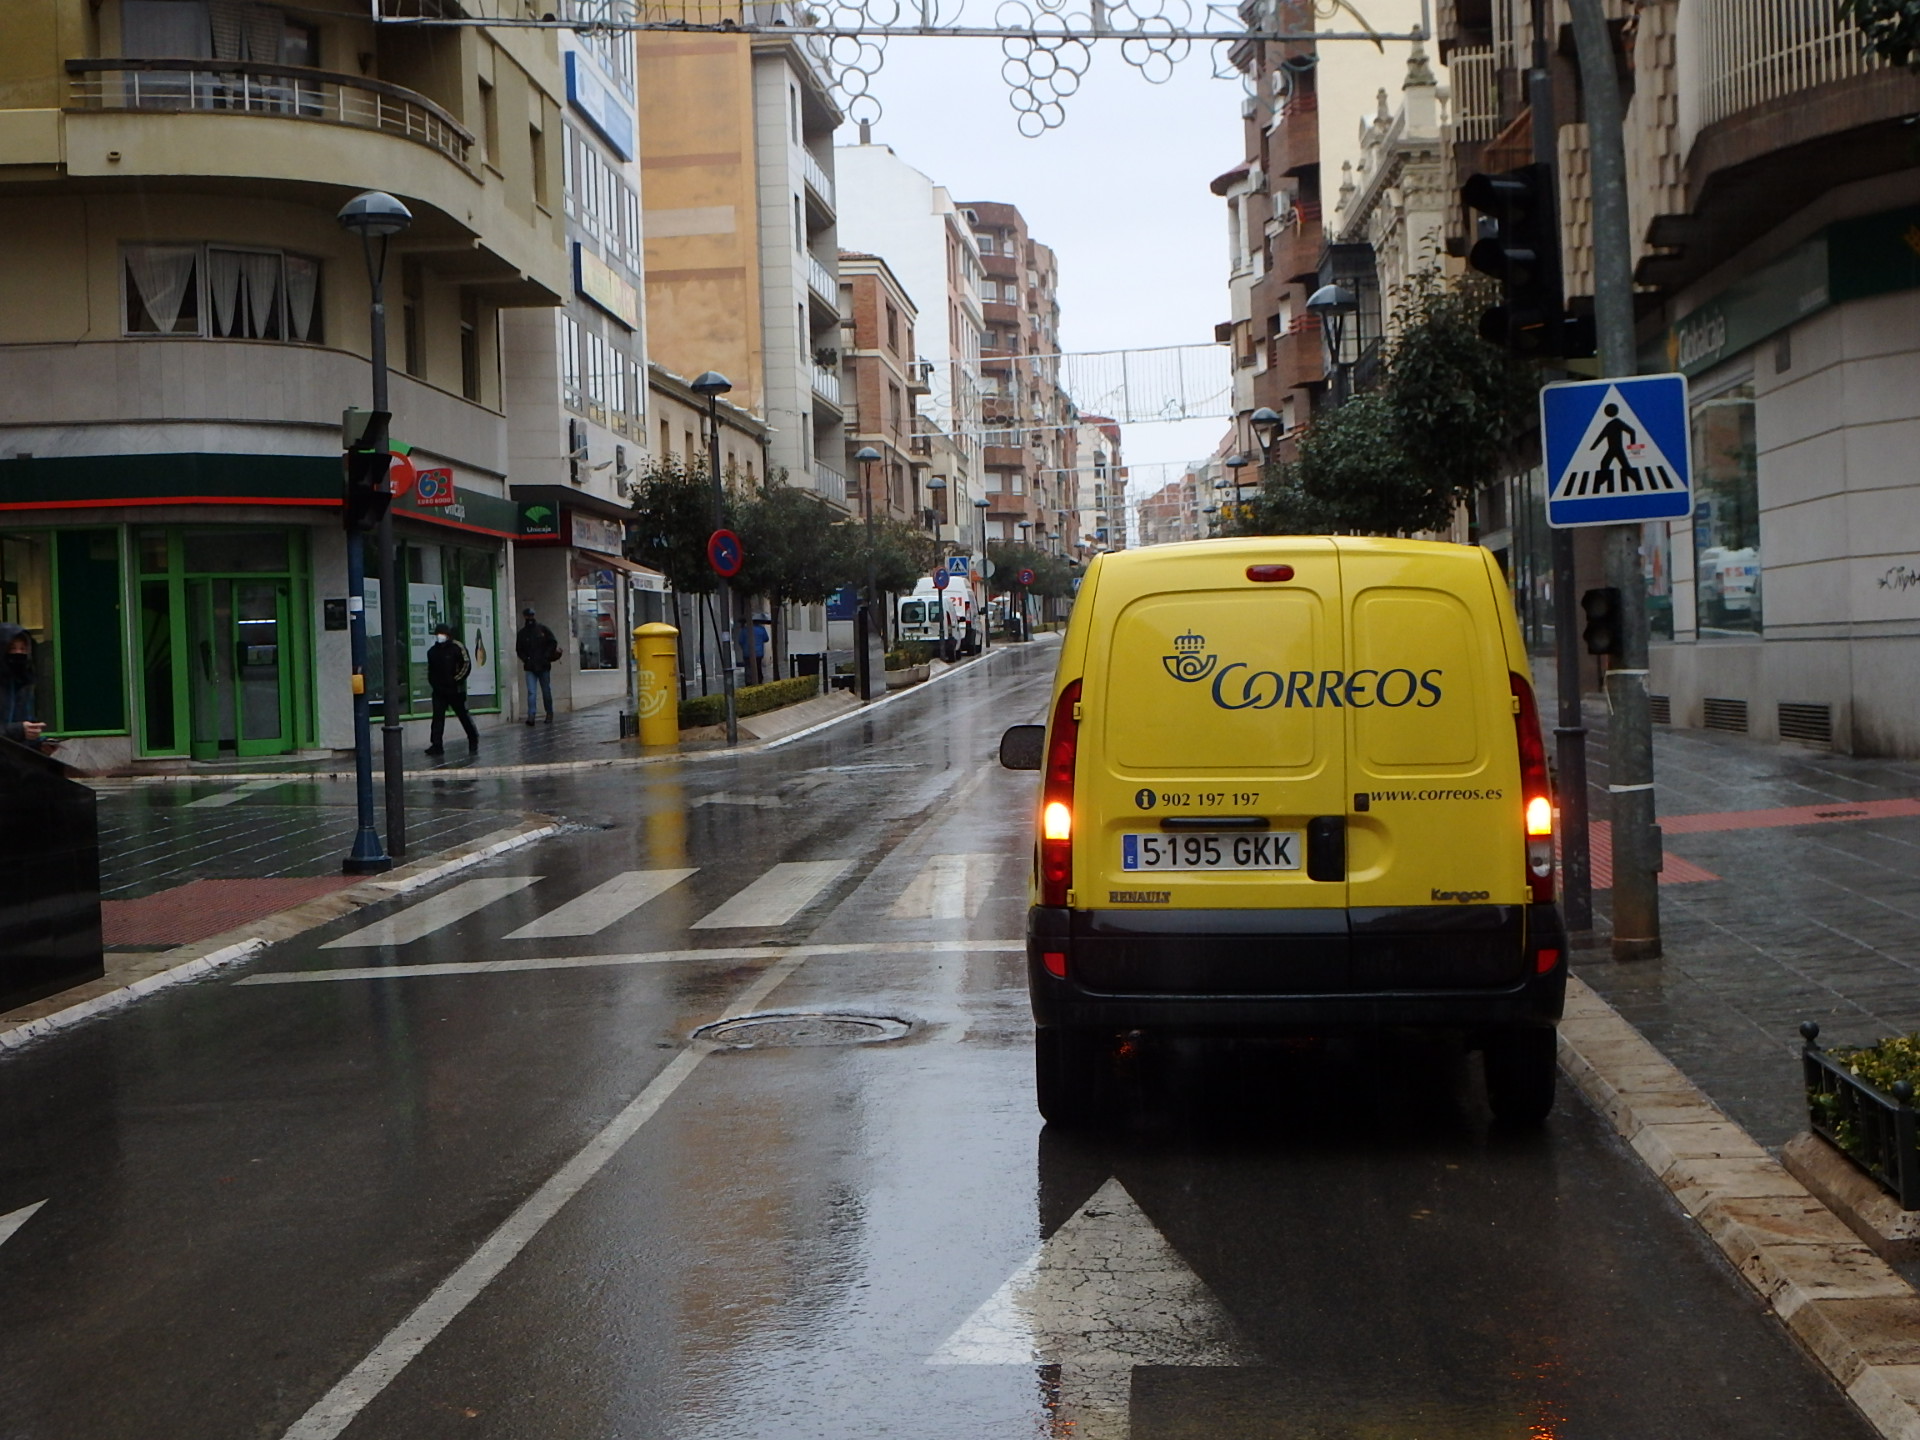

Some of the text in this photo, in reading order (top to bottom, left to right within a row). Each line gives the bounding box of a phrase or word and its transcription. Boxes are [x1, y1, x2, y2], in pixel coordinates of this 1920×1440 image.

[526, 524, 552, 534] Unicaja
[1211, 662, 1443, 710] CORREOS
[1161, 791, 1260, 807] 902 197 197
[1371, 788, 1503, 802] www.correos.es
[1143, 836, 1292, 866] 5195 GKK
[1127, 855, 1134, 864] E
[1108, 891, 1171, 904] RENAULT
[1431, 888, 1490, 903] Kangoo
